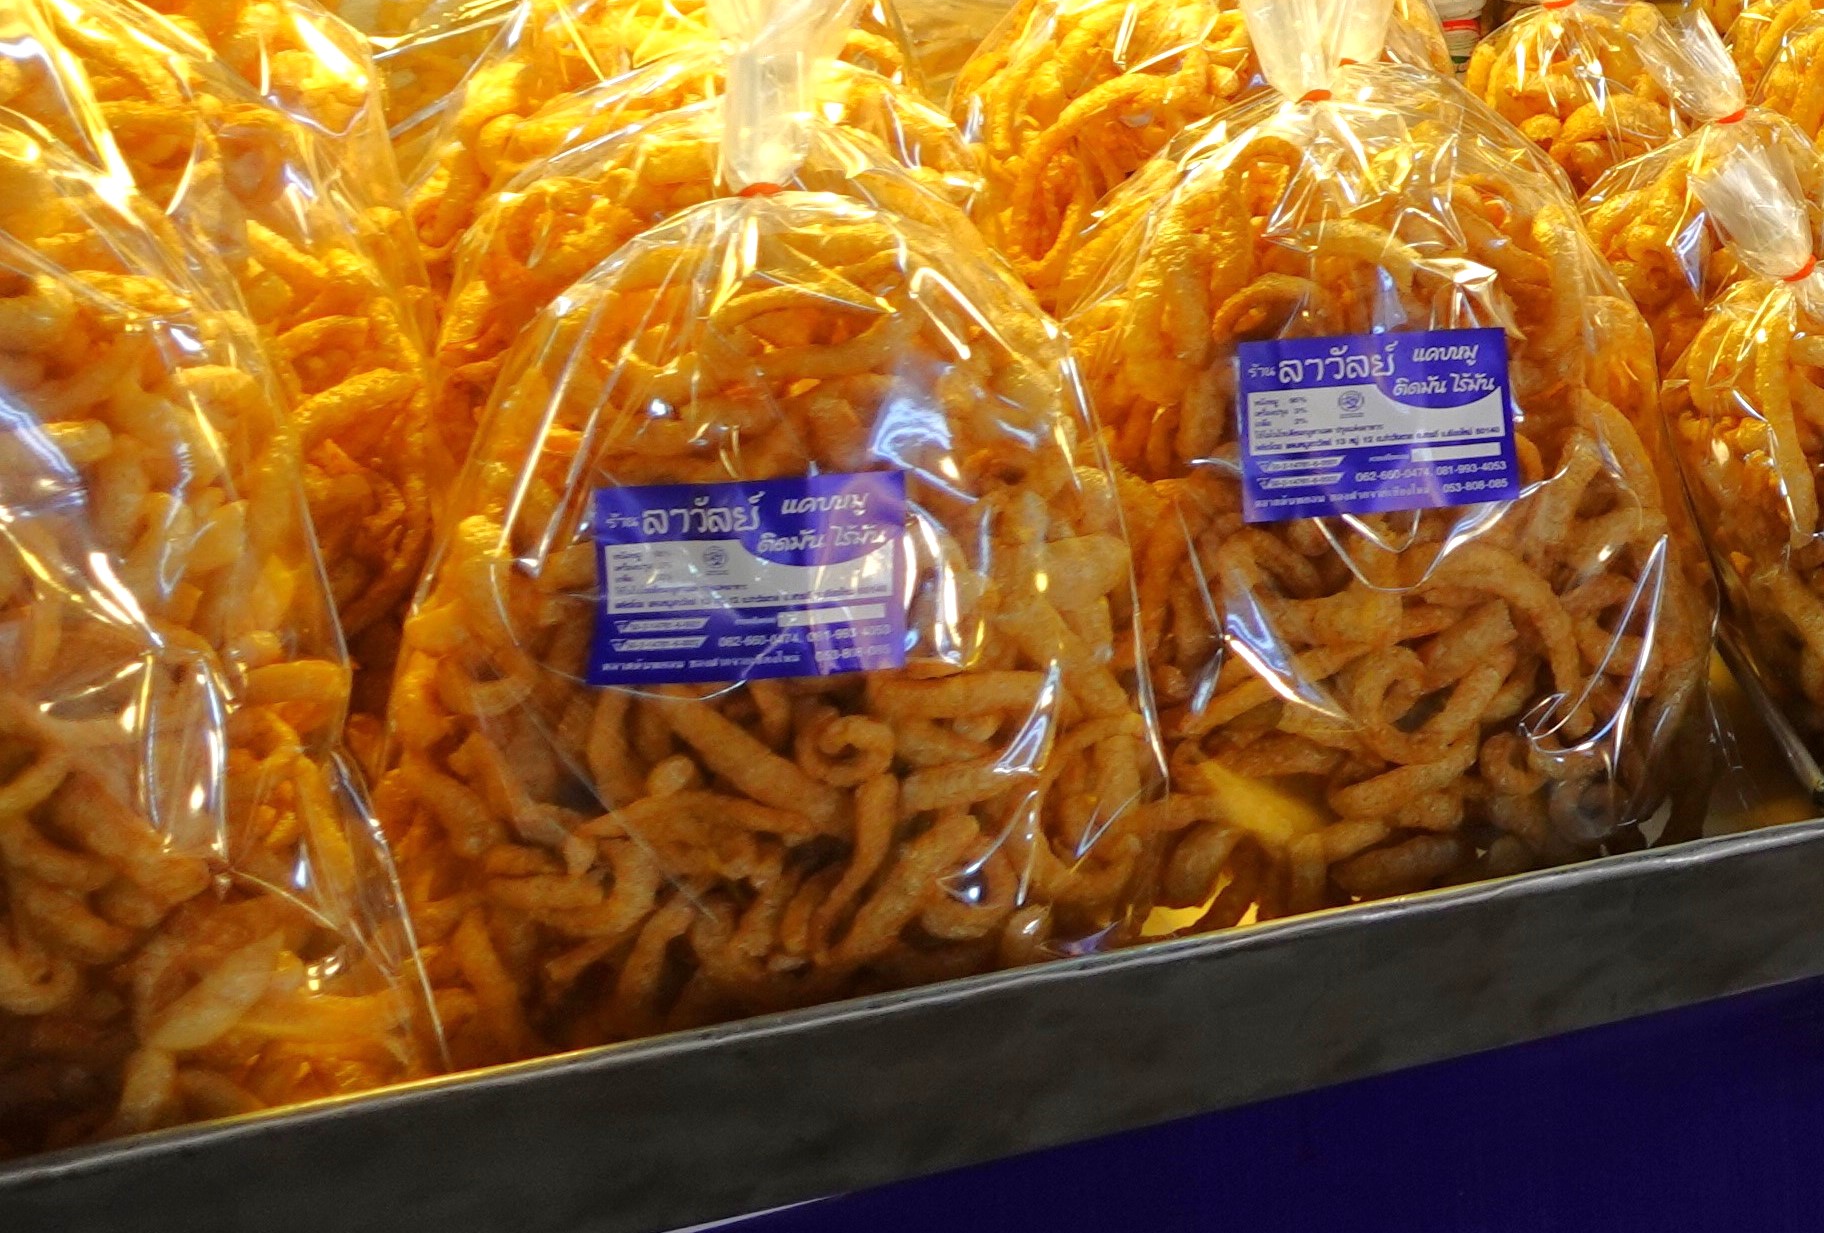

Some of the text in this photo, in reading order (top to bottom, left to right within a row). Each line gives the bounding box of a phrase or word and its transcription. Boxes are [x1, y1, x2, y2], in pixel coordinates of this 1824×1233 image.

[1278, 340, 1399, 384] ลาวัลย์
[1411, 343, 1480, 367] แคบหมู
[1393, 371, 1496, 398] ติดมัน ไร้มัน
[642, 489, 767, 537] ลาวัลย์
[780, 490, 870, 517] แคบหมู
[757, 523, 888, 555] ติดมัน ไร้มัน
